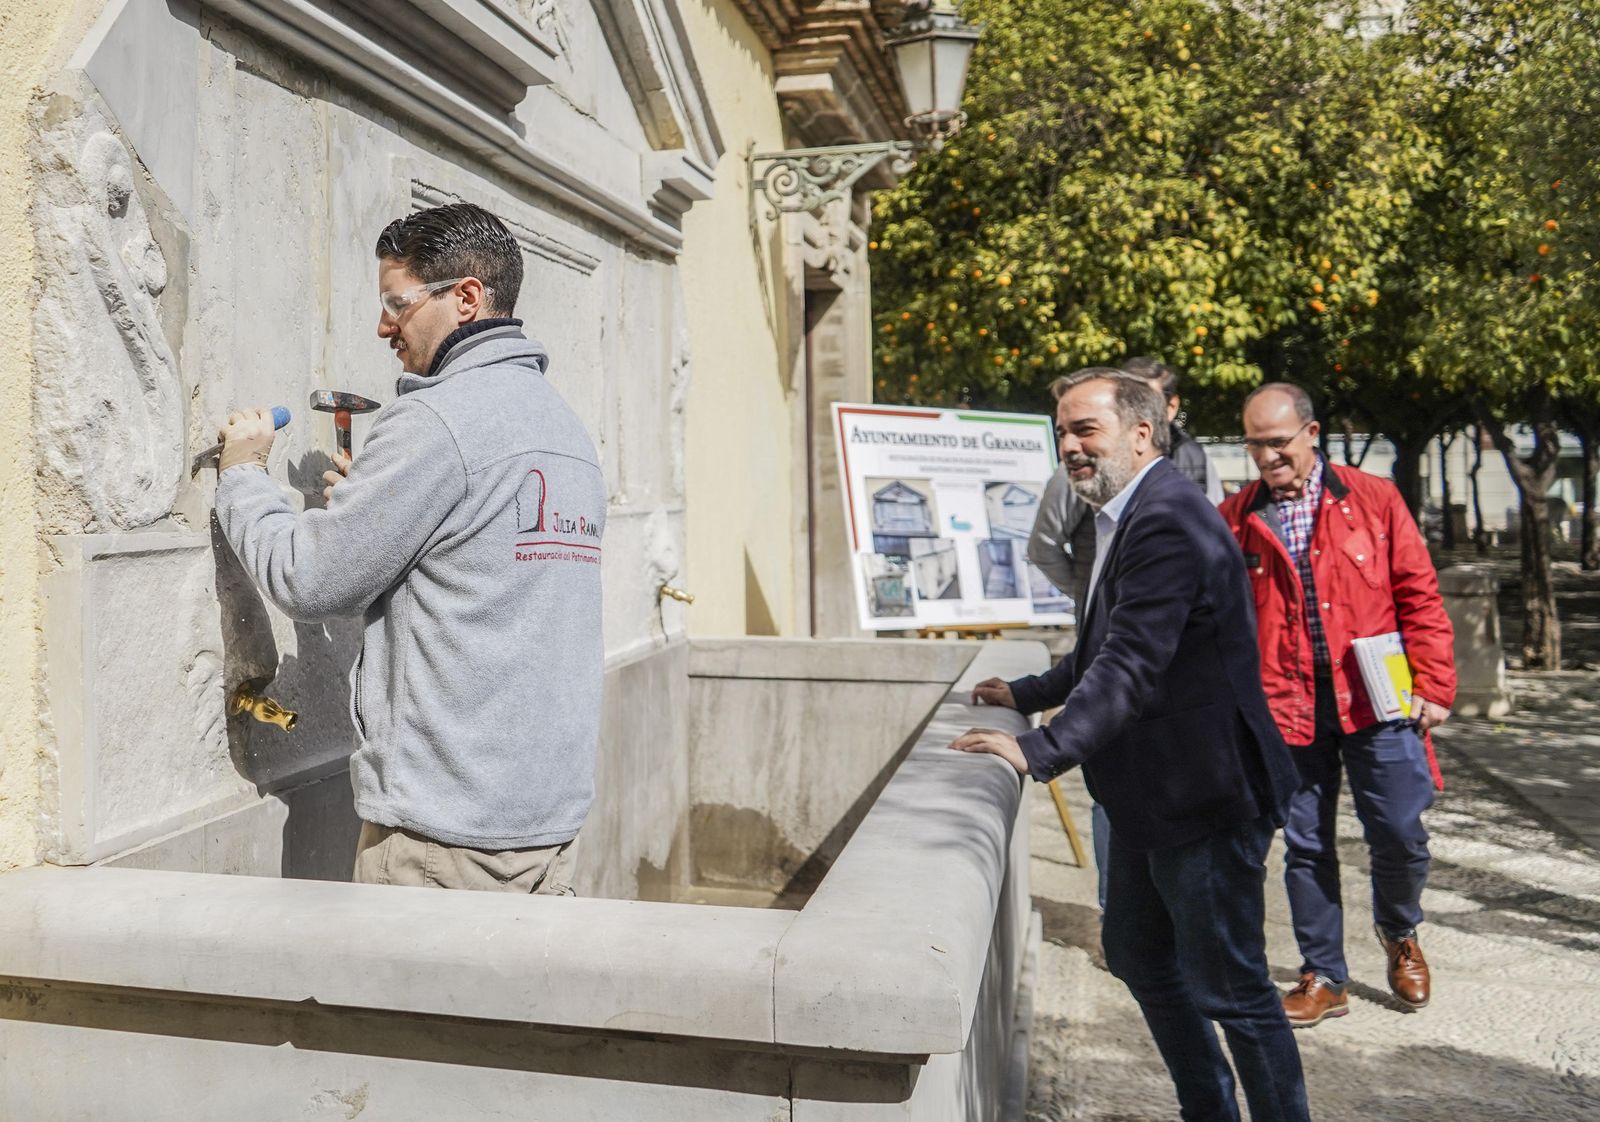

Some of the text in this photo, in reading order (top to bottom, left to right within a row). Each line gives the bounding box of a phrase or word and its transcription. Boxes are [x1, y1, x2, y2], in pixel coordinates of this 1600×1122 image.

[851, 424, 1044, 453] AYUNTAMIENTO DE GRANADA
